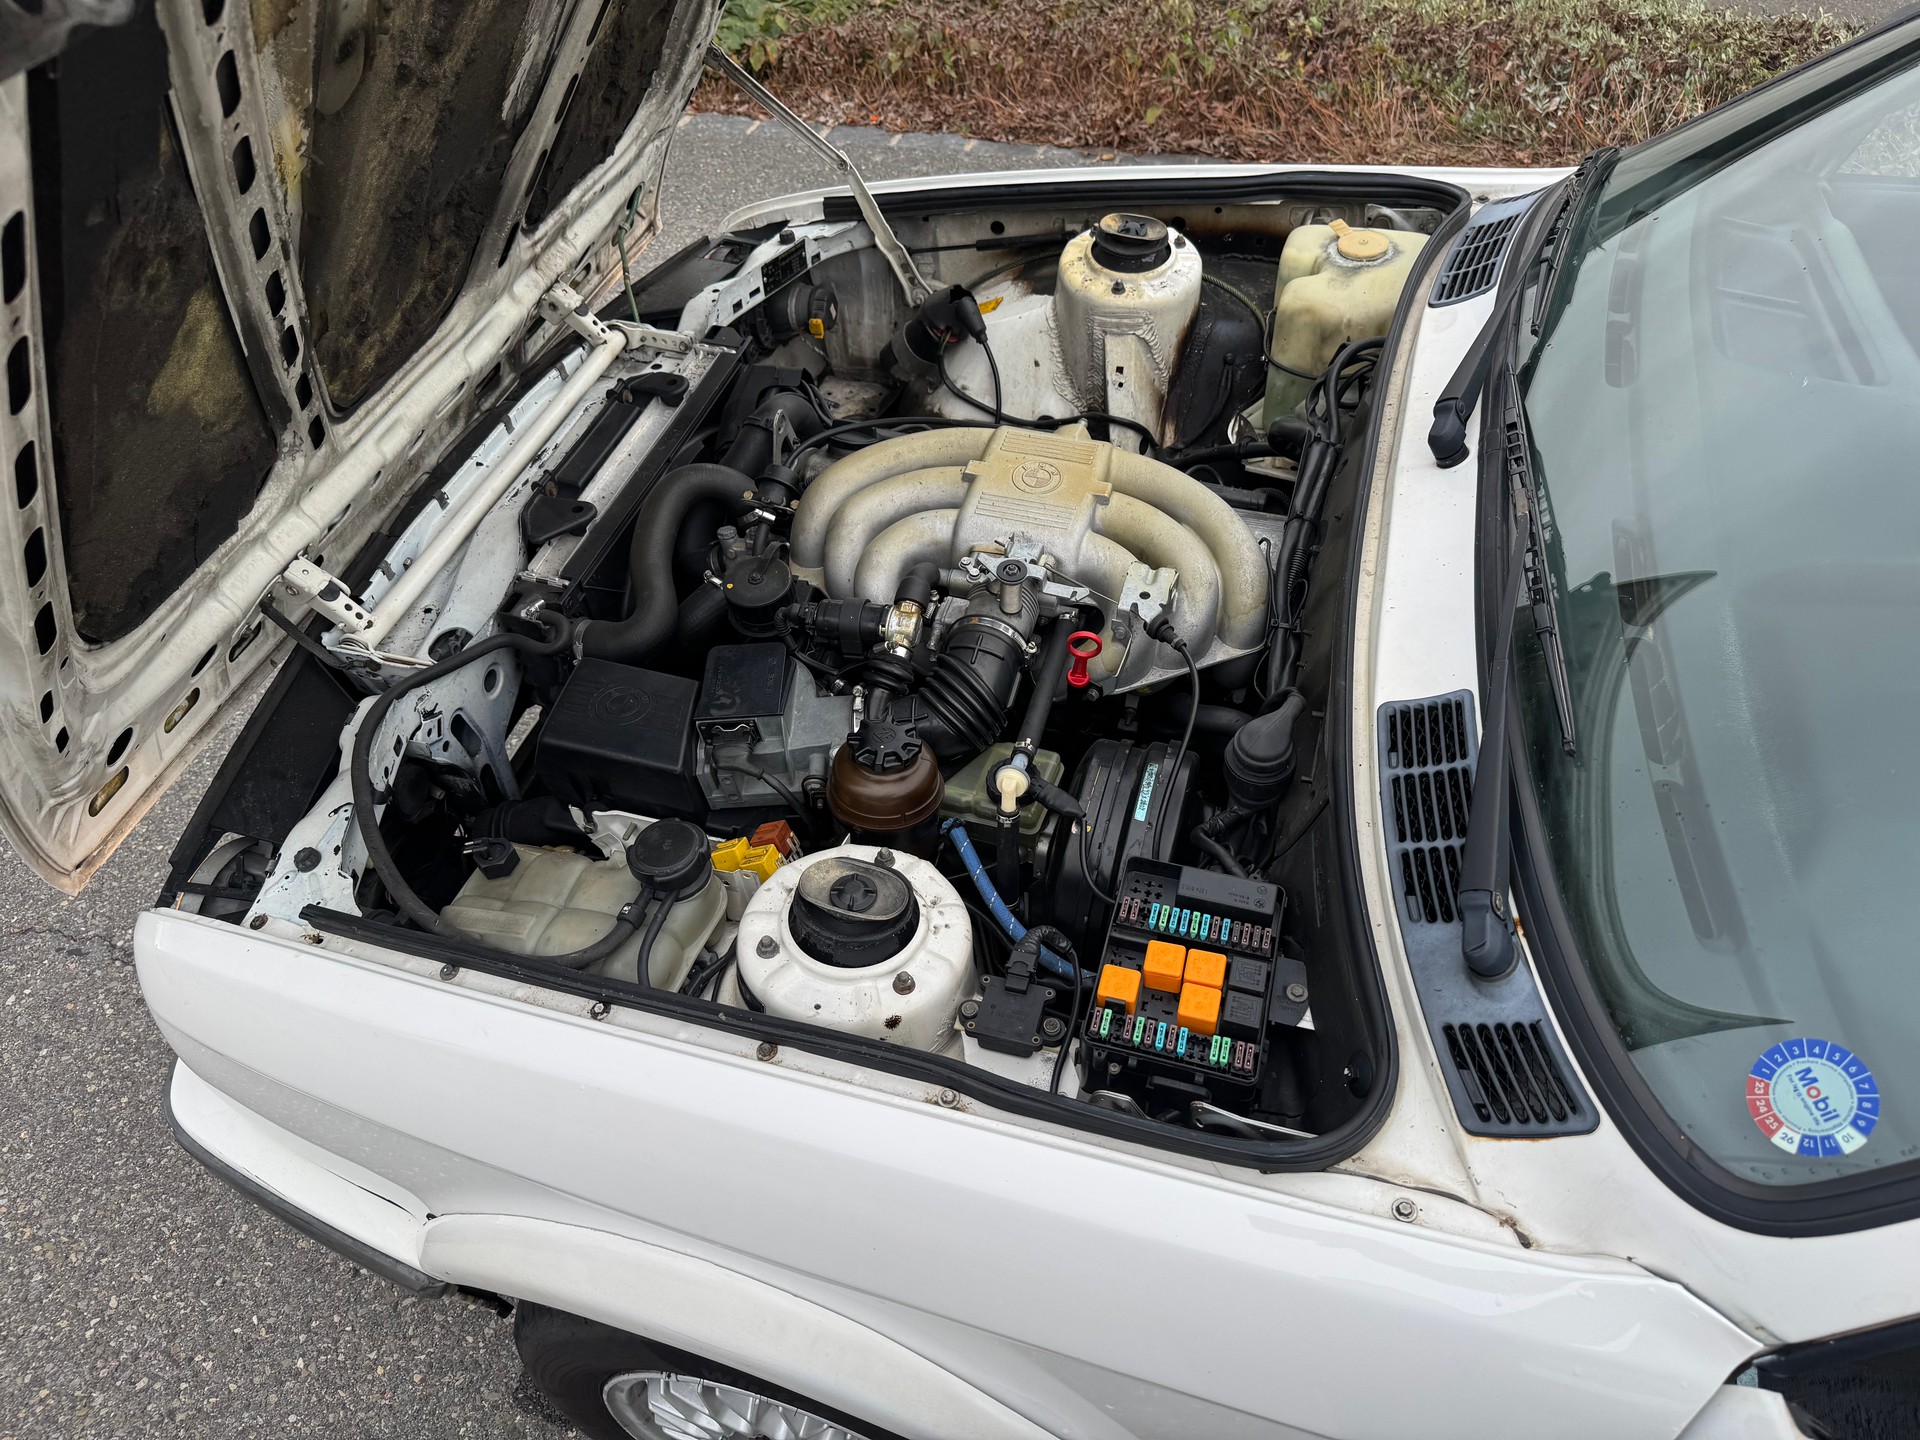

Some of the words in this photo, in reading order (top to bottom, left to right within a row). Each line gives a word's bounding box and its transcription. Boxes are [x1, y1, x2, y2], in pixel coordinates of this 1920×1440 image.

[1792, 1047, 1799, 1055] 3
[1813, 1046, 1819, 1054] 4
[1755, 1082, 1764, 1094] 23
[1795, 1067, 1840, 1122] Mobil
[1756, 1100, 1767, 1112] 24
[1800, 1097, 1814, 1118] engine
[1765, 1116, 1778, 1129] 25
[1780, 1132, 1794, 1144] 26
[1803, 1139, 1814, 1147] 12
[1825, 1139, 1835, 1147] 11
[1842, 1133, 1854, 1143] 10
